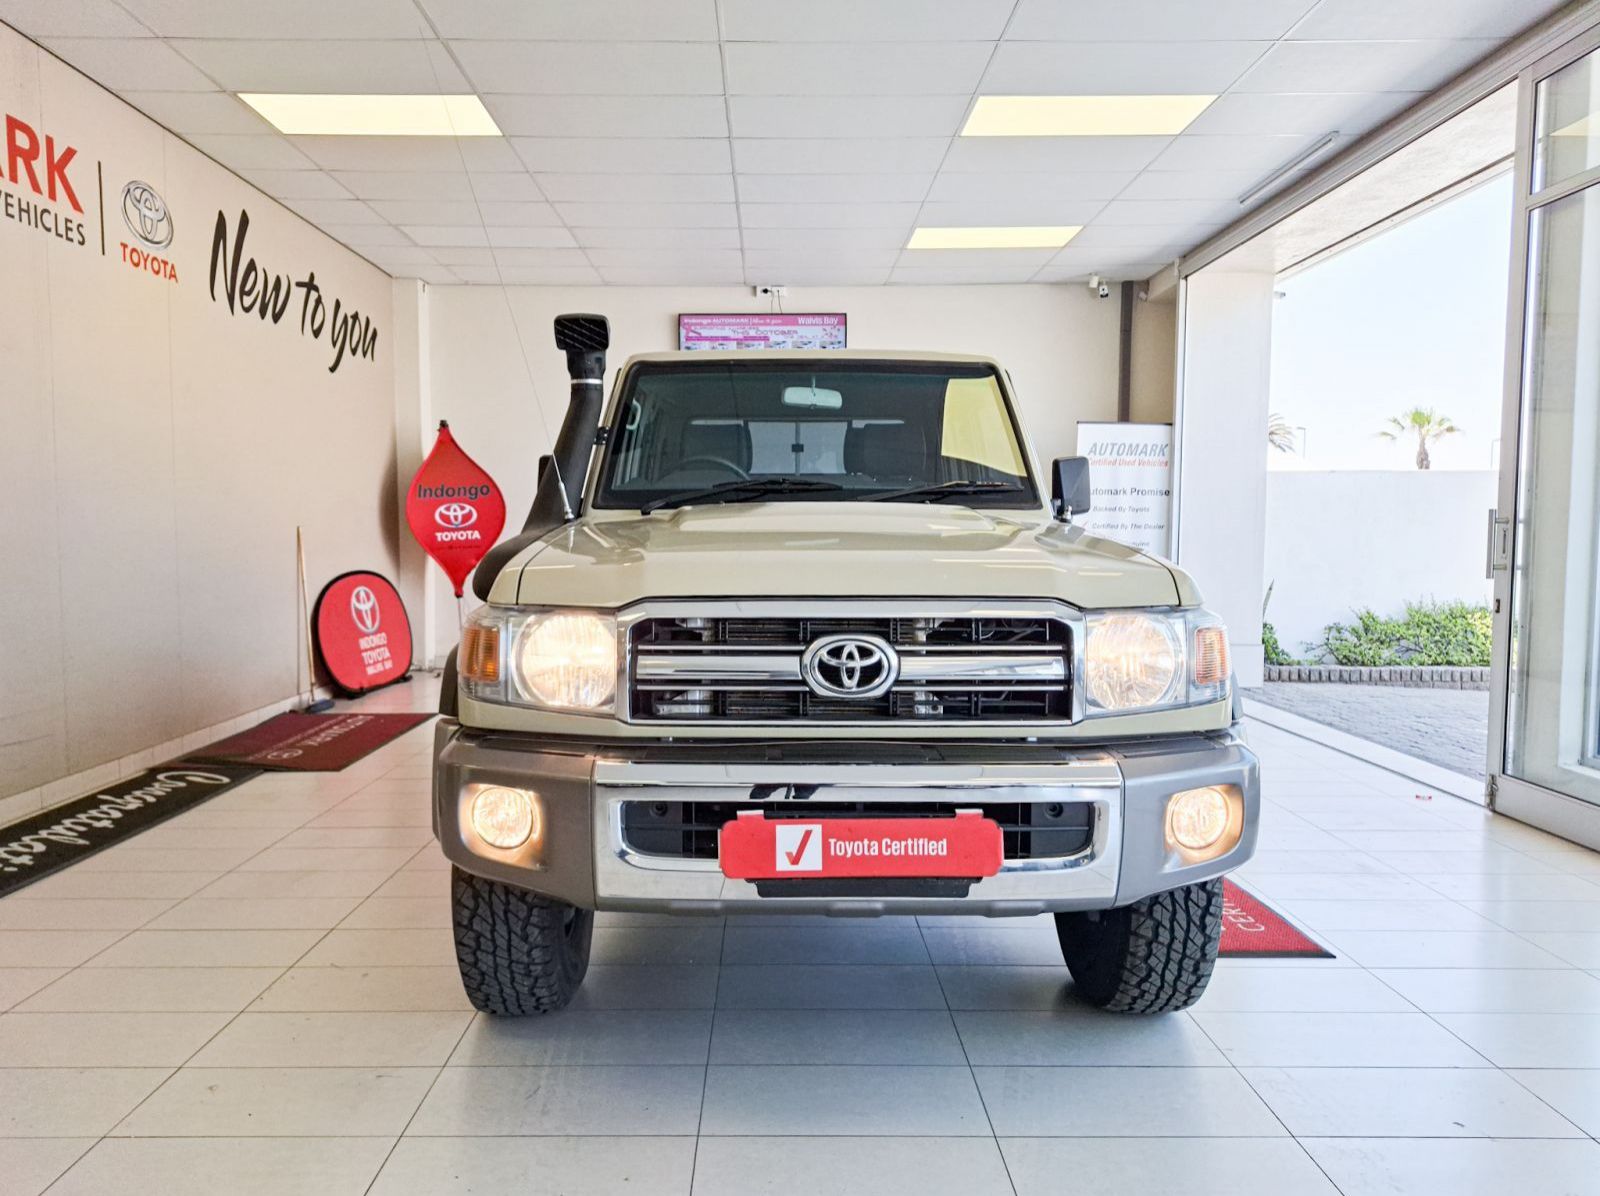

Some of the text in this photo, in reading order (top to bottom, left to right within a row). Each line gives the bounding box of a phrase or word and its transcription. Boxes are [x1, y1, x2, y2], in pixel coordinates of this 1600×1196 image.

[0, 114, 84, 214] RK
[0, 189, 86, 246] EHICLES
[120, 242, 178, 283] TOYOTA
[209, 209, 378, 373] New to you
[798, 317, 838, 326] Walvis Bay
[1088, 442, 1169, 457] AUTOMARK
[417, 484, 491, 500] Indongo
[1090, 487, 1170, 497] utomark Promise
[435, 530, 481, 542] TOYOTA
[828, 837, 948, 859] Toyota Certified
